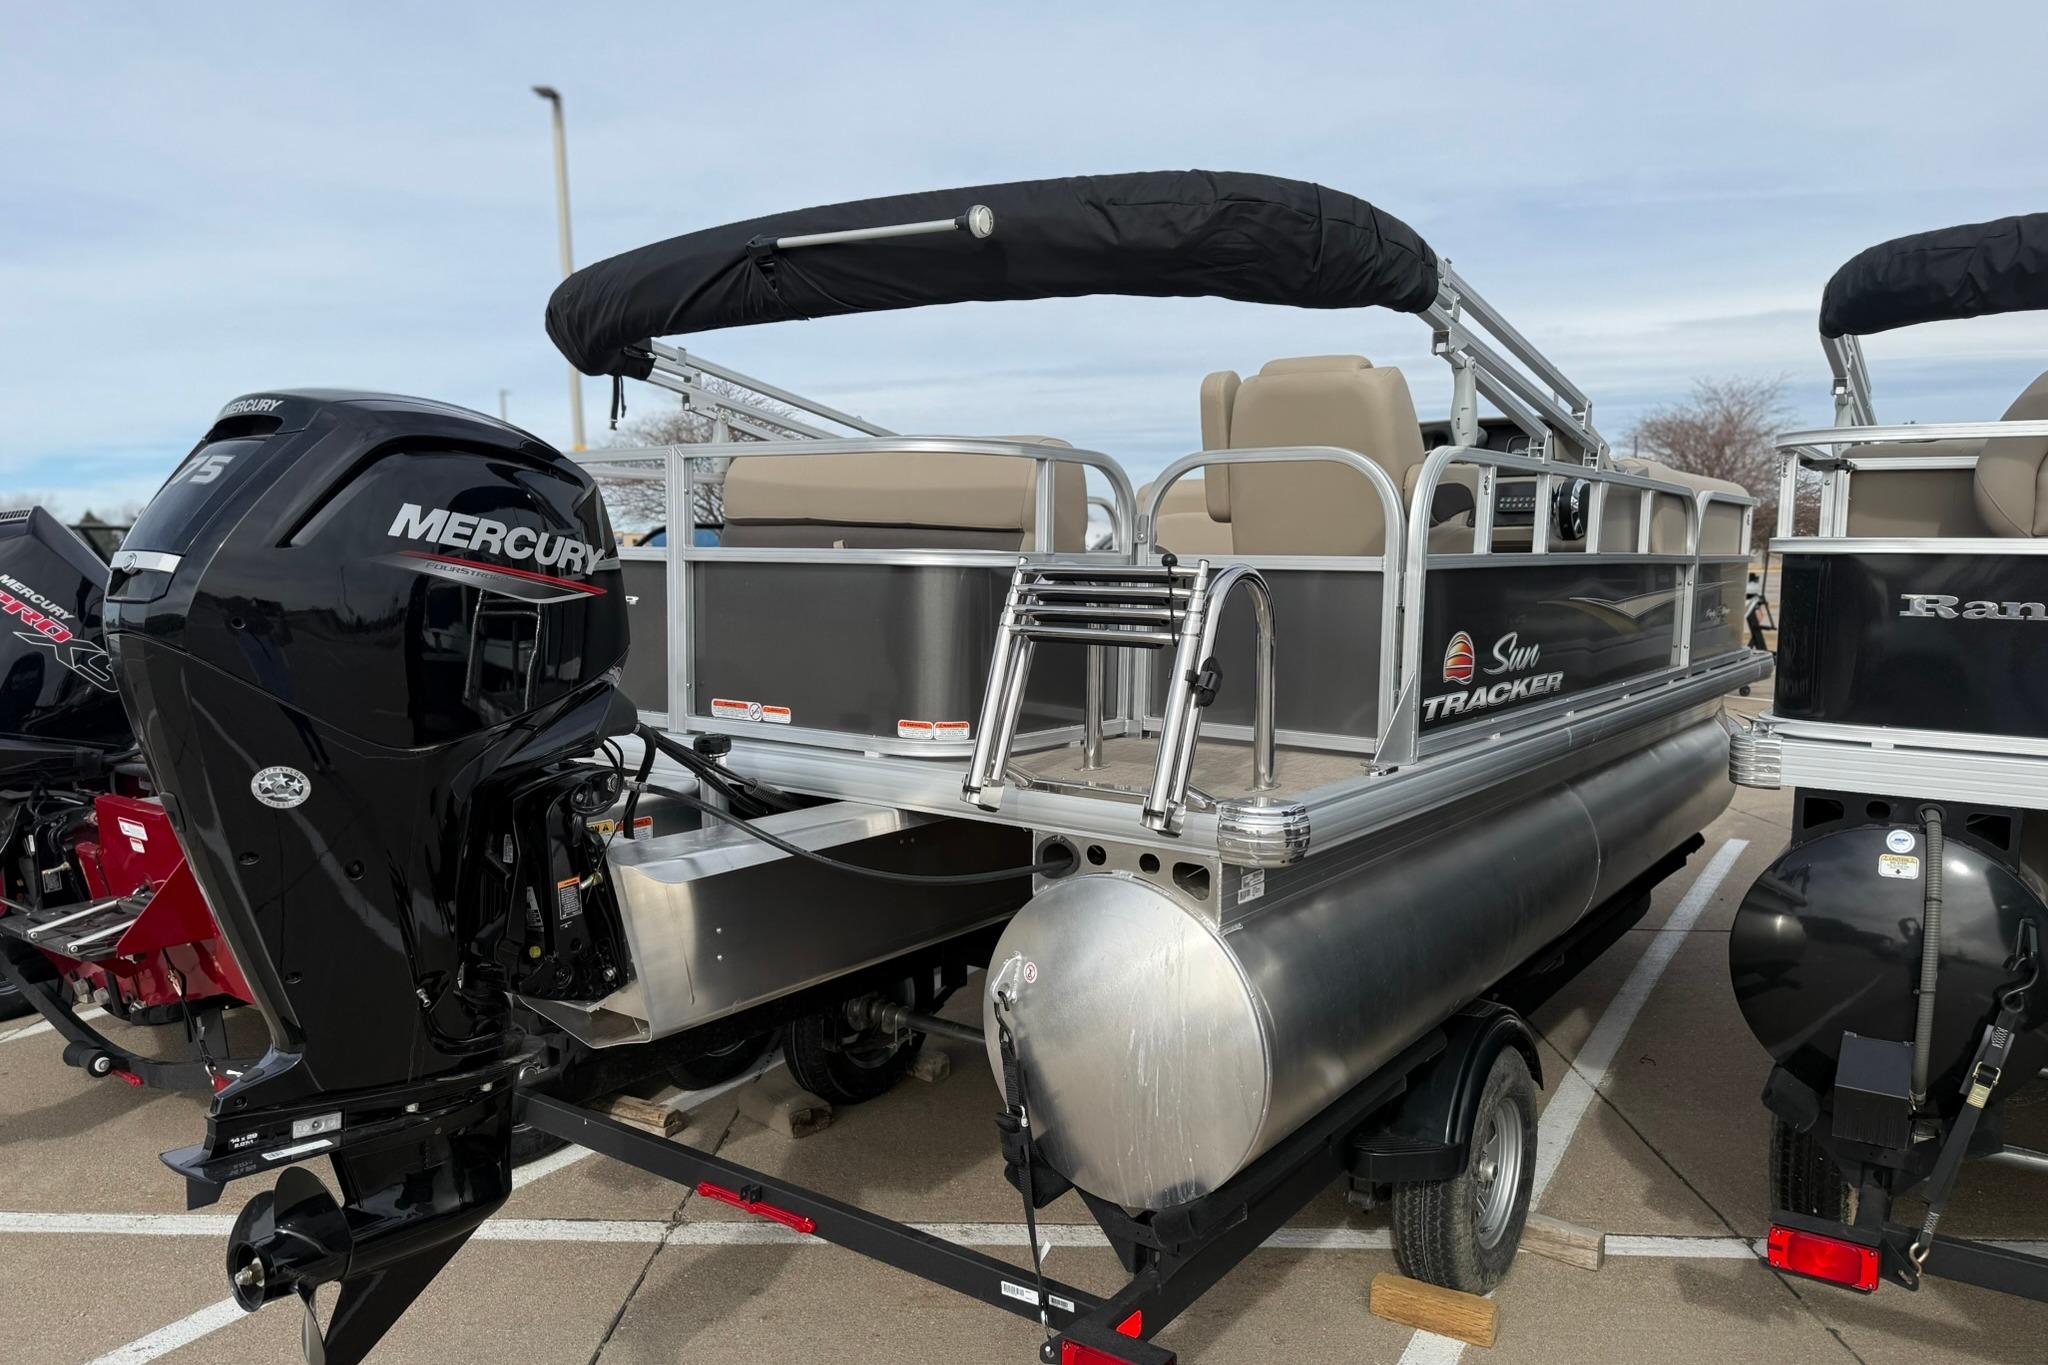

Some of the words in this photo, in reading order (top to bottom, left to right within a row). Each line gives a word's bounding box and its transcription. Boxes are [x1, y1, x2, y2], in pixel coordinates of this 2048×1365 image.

[225, 398, 285, 415] MERCURY
[387, 502, 606, 576] MERCURY
[0, 573, 76, 620] MERCURY
[1899, 593, 2048, 621] Ran
[1482, 631, 1541, 675] Sun
[1422, 671, 1564, 723] TRACKER
